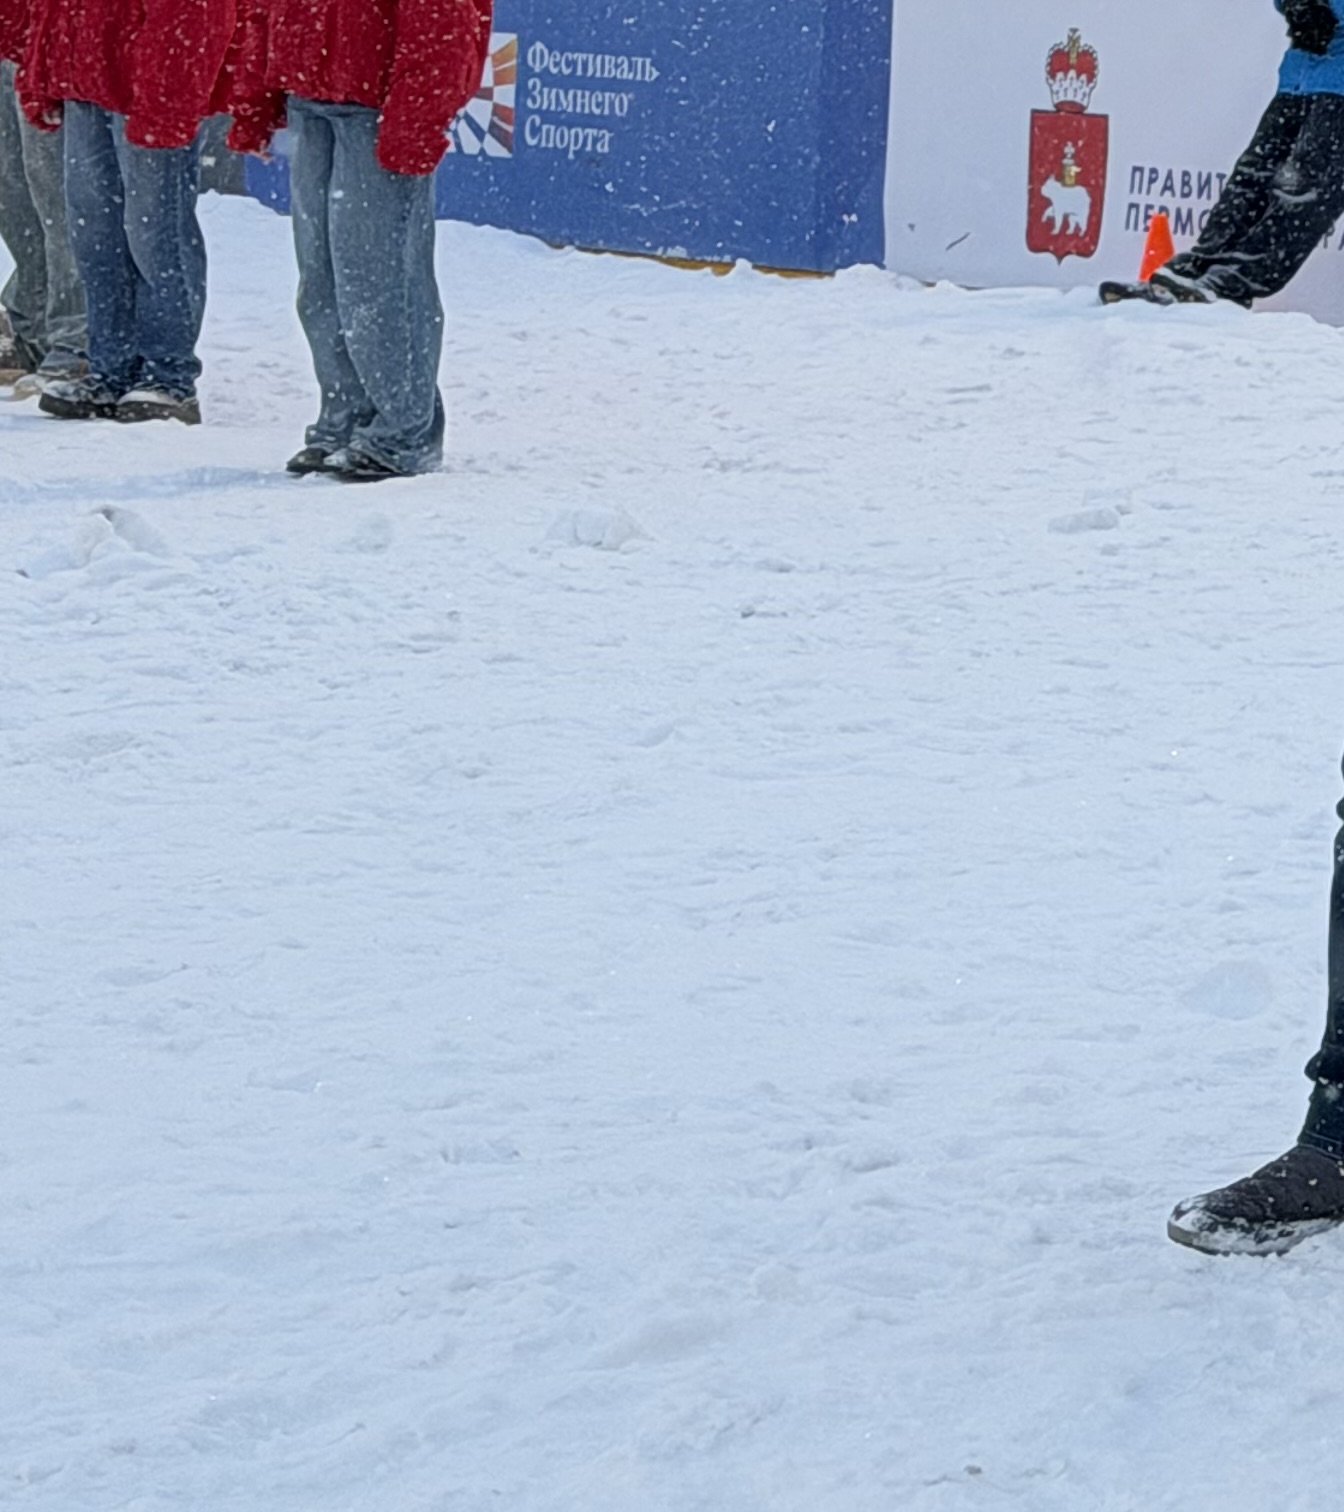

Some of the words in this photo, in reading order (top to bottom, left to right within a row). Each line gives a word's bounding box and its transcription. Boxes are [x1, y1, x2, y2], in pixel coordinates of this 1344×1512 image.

[526, 40, 661, 82] Фестиваль
[526, 77, 629, 118] Зимнего
[524, 114, 614, 161] Спорта
[1129, 165, 1227, 201] ПРАВИТ
